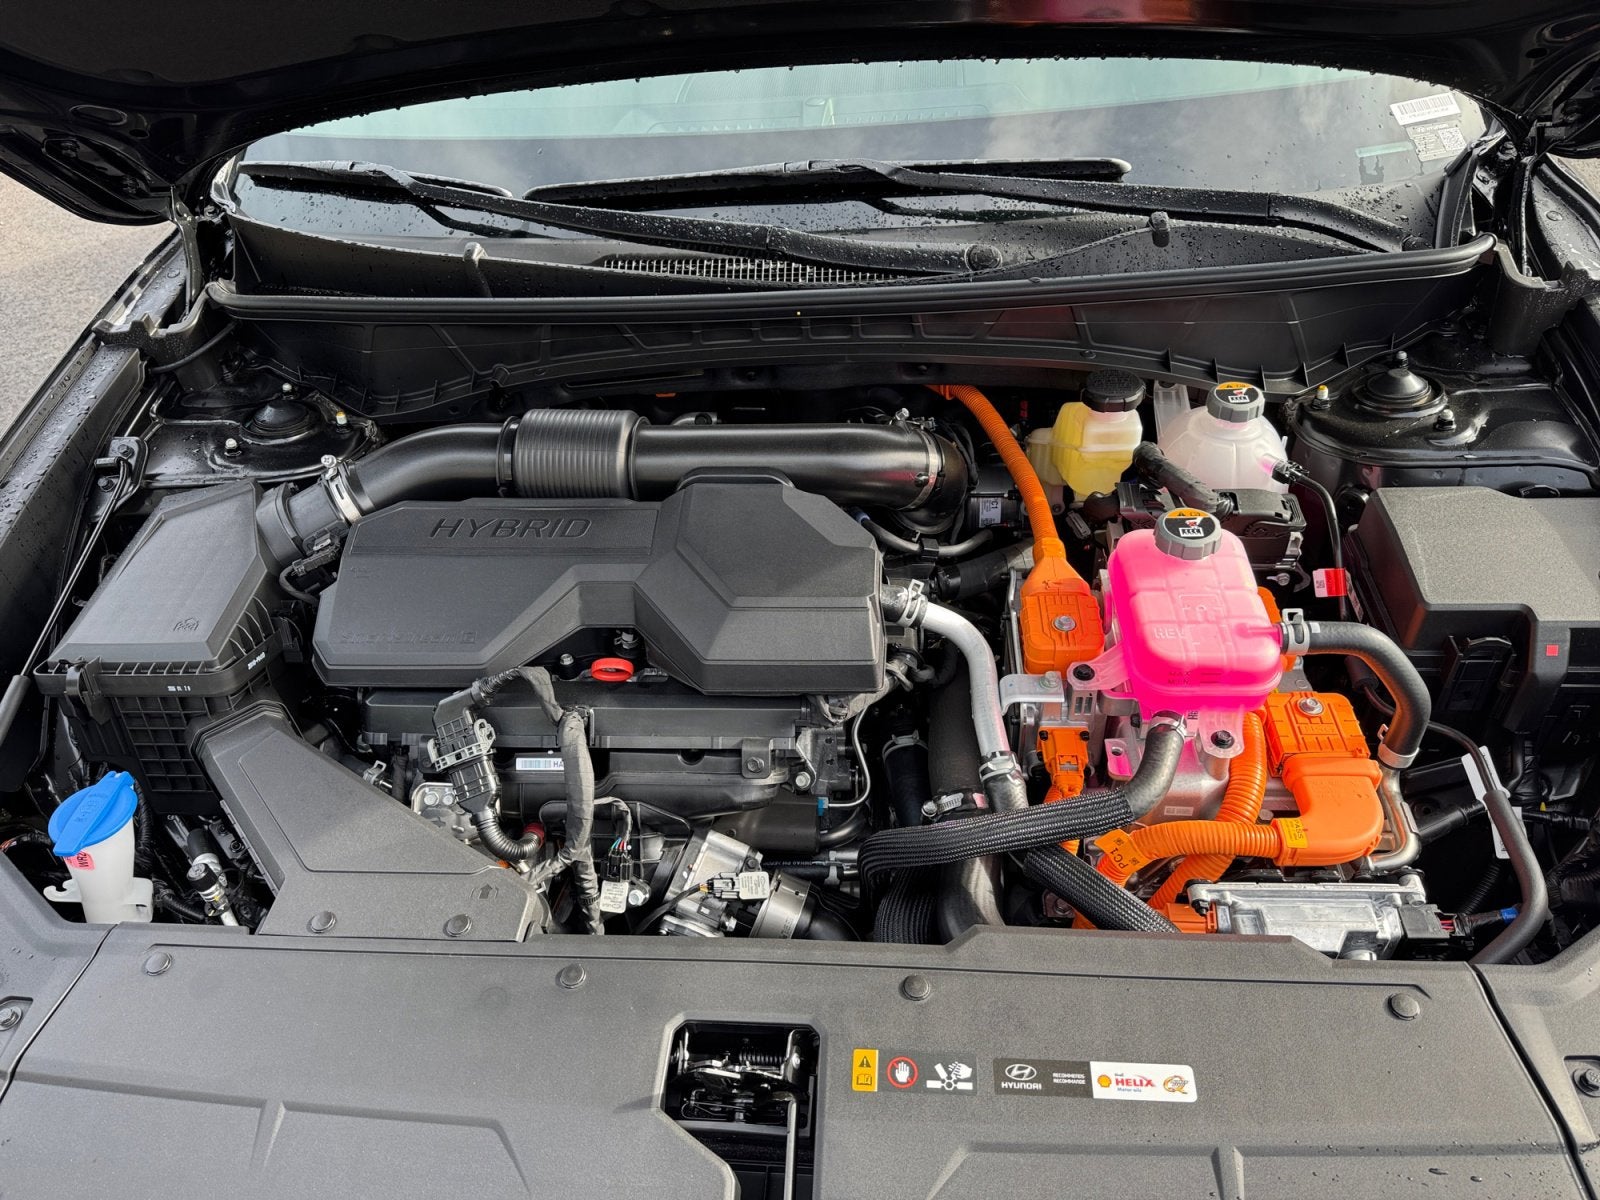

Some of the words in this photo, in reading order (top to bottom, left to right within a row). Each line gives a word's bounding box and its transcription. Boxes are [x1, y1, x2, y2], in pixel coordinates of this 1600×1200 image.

[430, 518, 592, 539] HYBRID
[1109, 847, 1129, 869] PC1
[1001, 1081, 1042, 1090] HYUNDAI
[1115, 1077, 1154, 1088] HELIX
